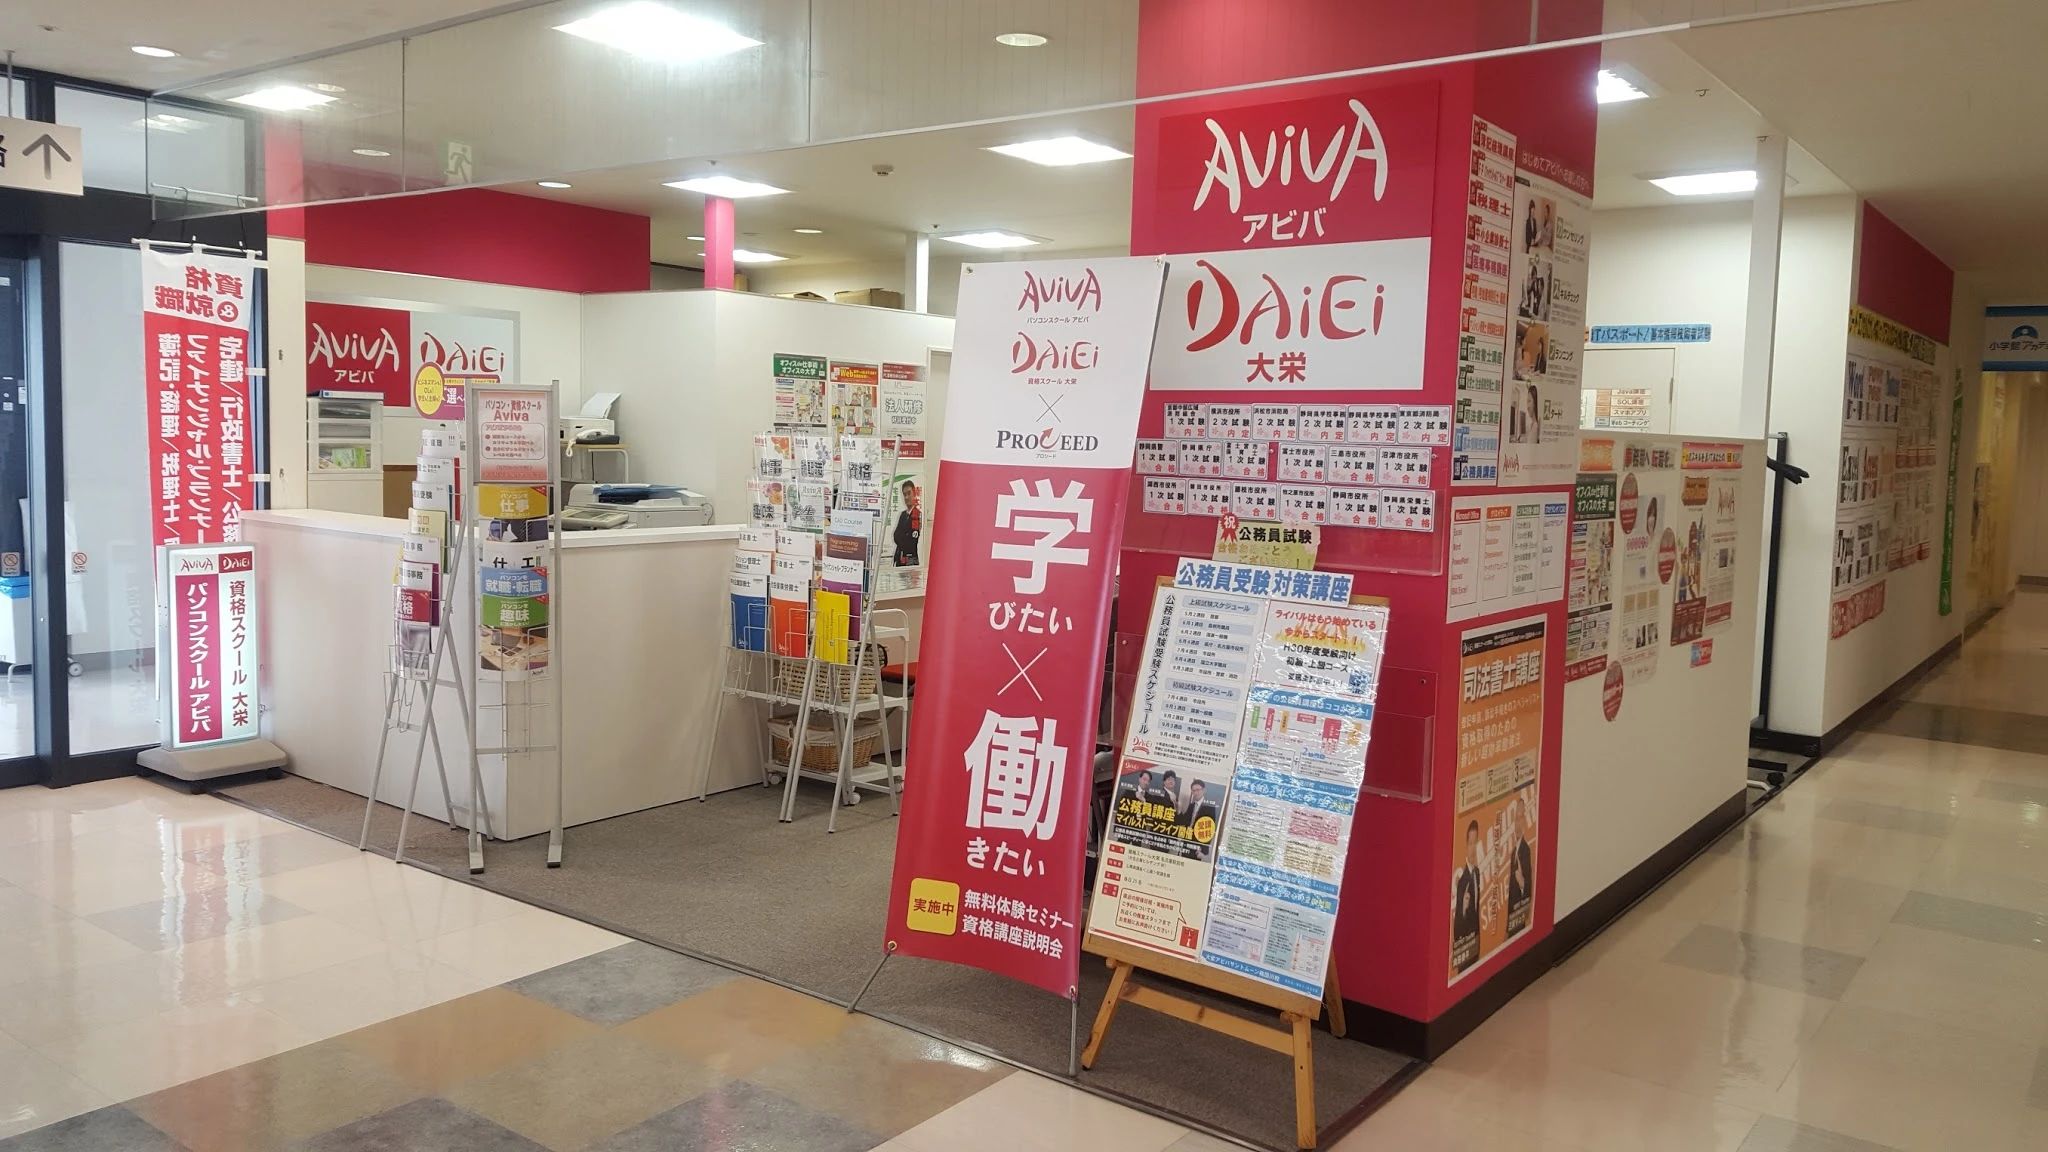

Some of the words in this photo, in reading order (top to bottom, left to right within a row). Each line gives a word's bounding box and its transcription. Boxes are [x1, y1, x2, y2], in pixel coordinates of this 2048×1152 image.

[1478, 191, 1511, 217] 税理士
[1242, 207, 1327, 243] アビバ
[334, 369, 375, 384] アビバ
[1247, 352, 1307, 383] 大栄
[485, 400, 542, 412] パソコン・資格スクール
[494, 410, 529, 422] Aviva
[884, 397, 923, 415] 法人研修
[1139, 443, 1164, 451] 静岡県警
[1330, 450, 1366, 458] 三島市役所
[1382, 452, 1419, 460] 沼津市役所
[1462, 467, 1497, 479] 公務員講座
[1234, 486, 1267, 494] 藤枝市役所
[1333, 492, 1369, 500] 静岡市役所
[500, 499, 529, 514] 仕事
[1384, 496, 1430, 506] 静岡県栄養士
[1224, 515, 1236, 528] 祝
[990, 477, 1094, 594] 学
[1239, 526, 1313, 544] 公務員試験
[485, 578, 543, 593] 就職・転職
[1177, 562, 1351, 603] 公務員受験対策講座
[500, 609, 530, 622] 趣味
[1188, 598, 1251, 613] 上級試験スケジュール
[989, 600, 1073, 634] びたい
[1275, 609, 1377, 630] ライバルはもう始めている
[187, 583, 211, 691] パソコンスクール
[229, 581, 248, 687] 資格スクール
[1139, 594, 1176, 735] 公務員試験受験スケジュール
[1464, 650, 1541, 703] 司法書士講座
[190, 692, 212, 734] アビバ
[232, 691, 249, 728] 大栄
[963, 708, 1069, 841] 働
[1118, 797, 1176, 822] 公務員講座
[1115, 813, 1194, 840] マイルストーンライブ開催
[965, 836, 1046, 878] きたい
[912, 897, 955, 918] 実施中
[964, 889, 1075, 932] 無料体験セミナー
[961, 916, 1064, 961] 資格講座説明会
